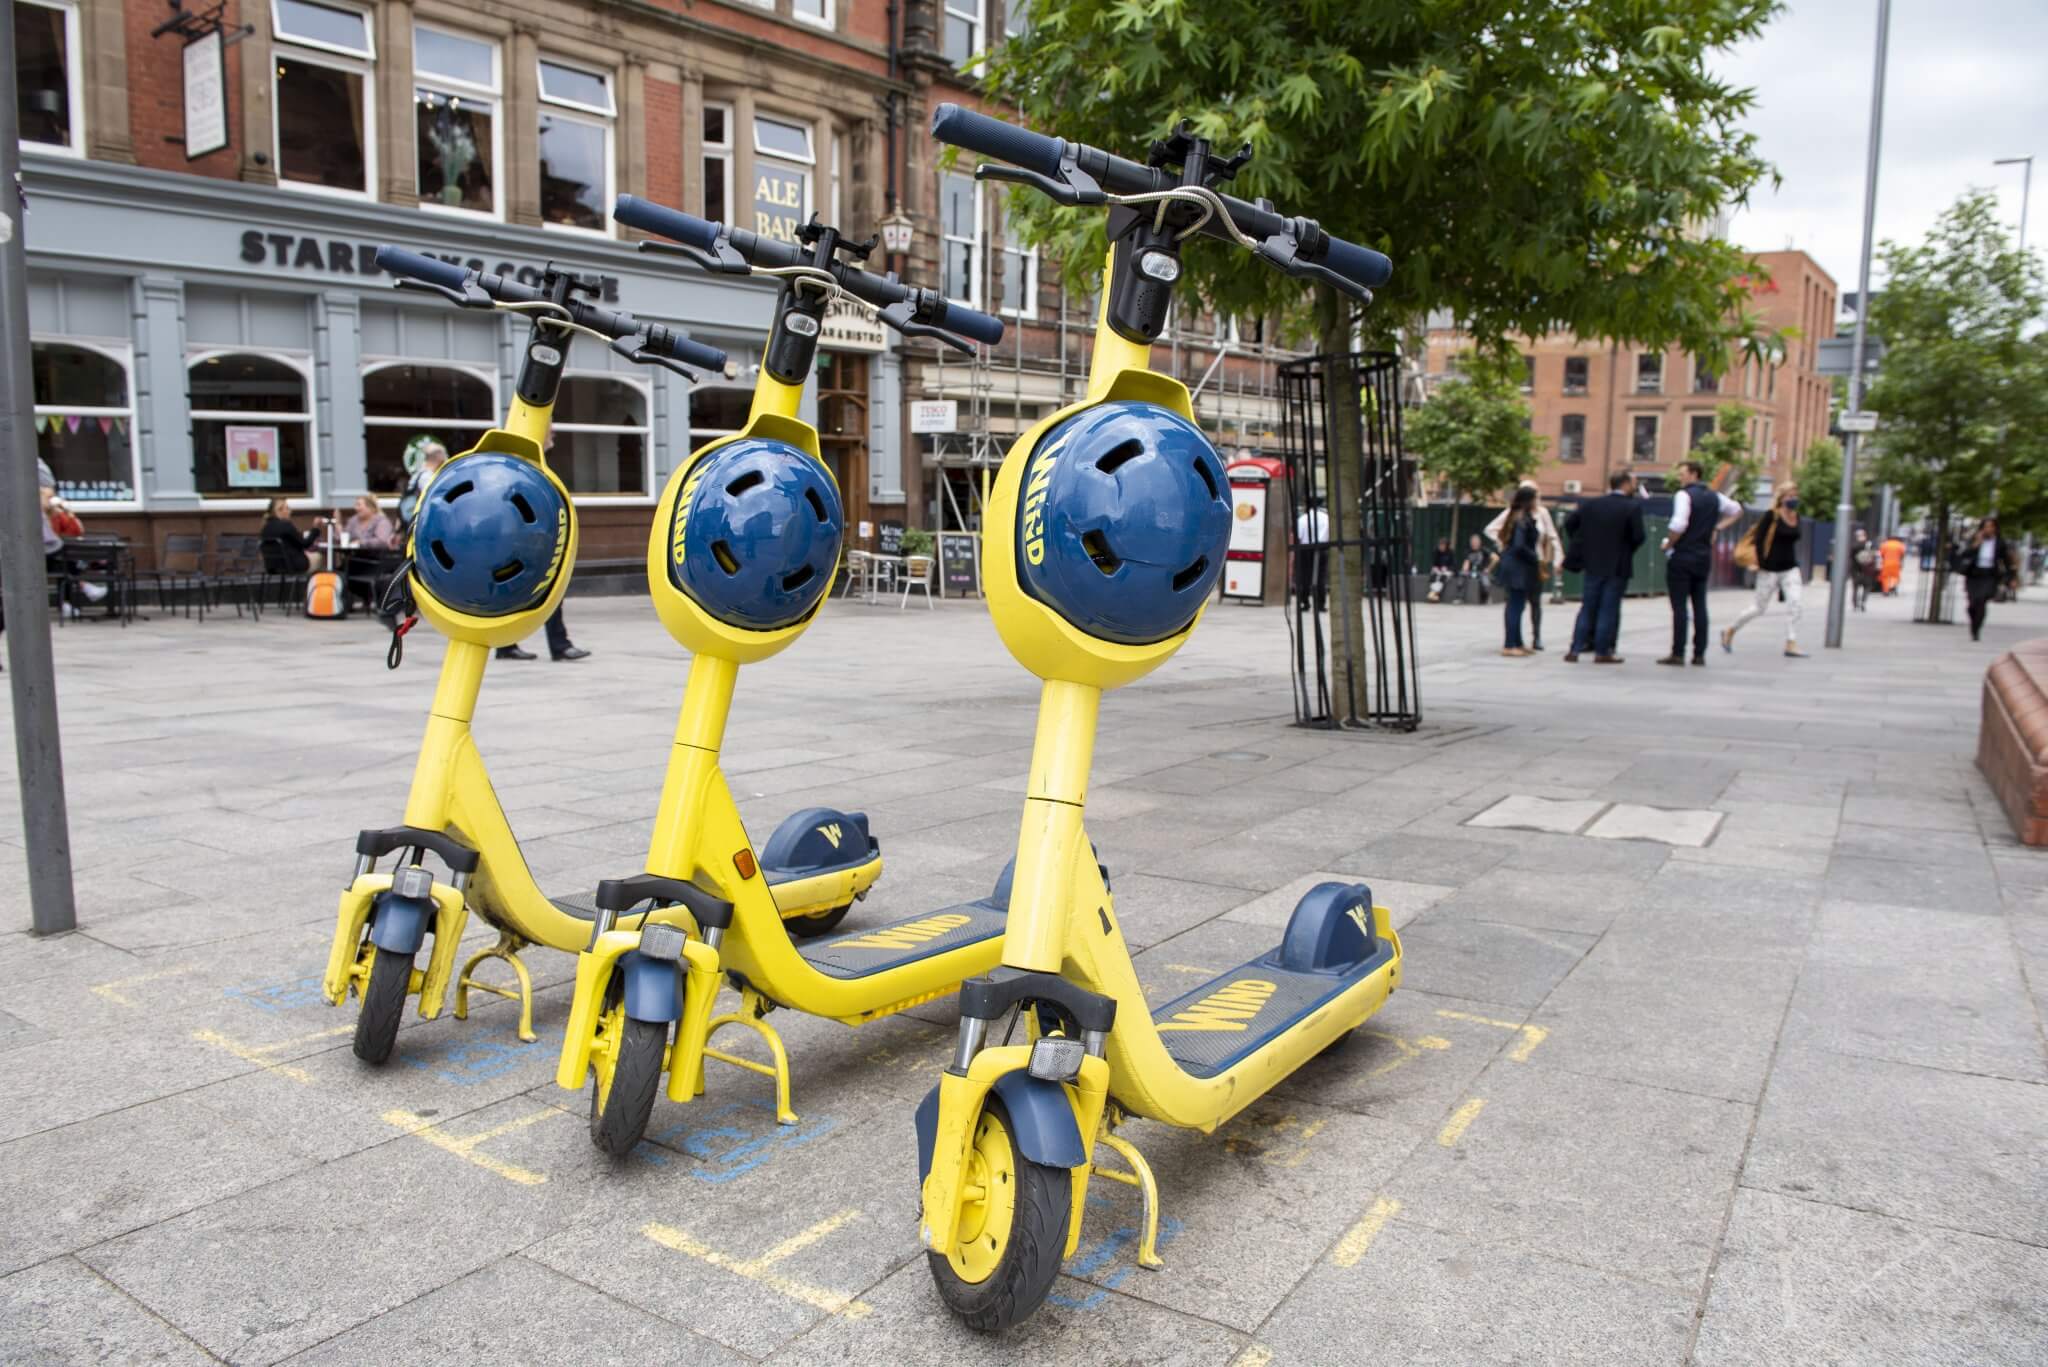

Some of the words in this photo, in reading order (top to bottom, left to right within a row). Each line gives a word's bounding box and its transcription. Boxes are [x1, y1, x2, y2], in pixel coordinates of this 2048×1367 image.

[754, 175, 800, 208] ALE
[755, 211, 802, 244] BAR
[846, 330, 882, 343] BISTRO
[673, 458, 715, 565] WIND
[1025, 429, 1075, 566] WIND
[816, 823, 842, 848] W
[828, 914, 972, 949] WIND
[1155, 979, 1277, 1031] WIND
